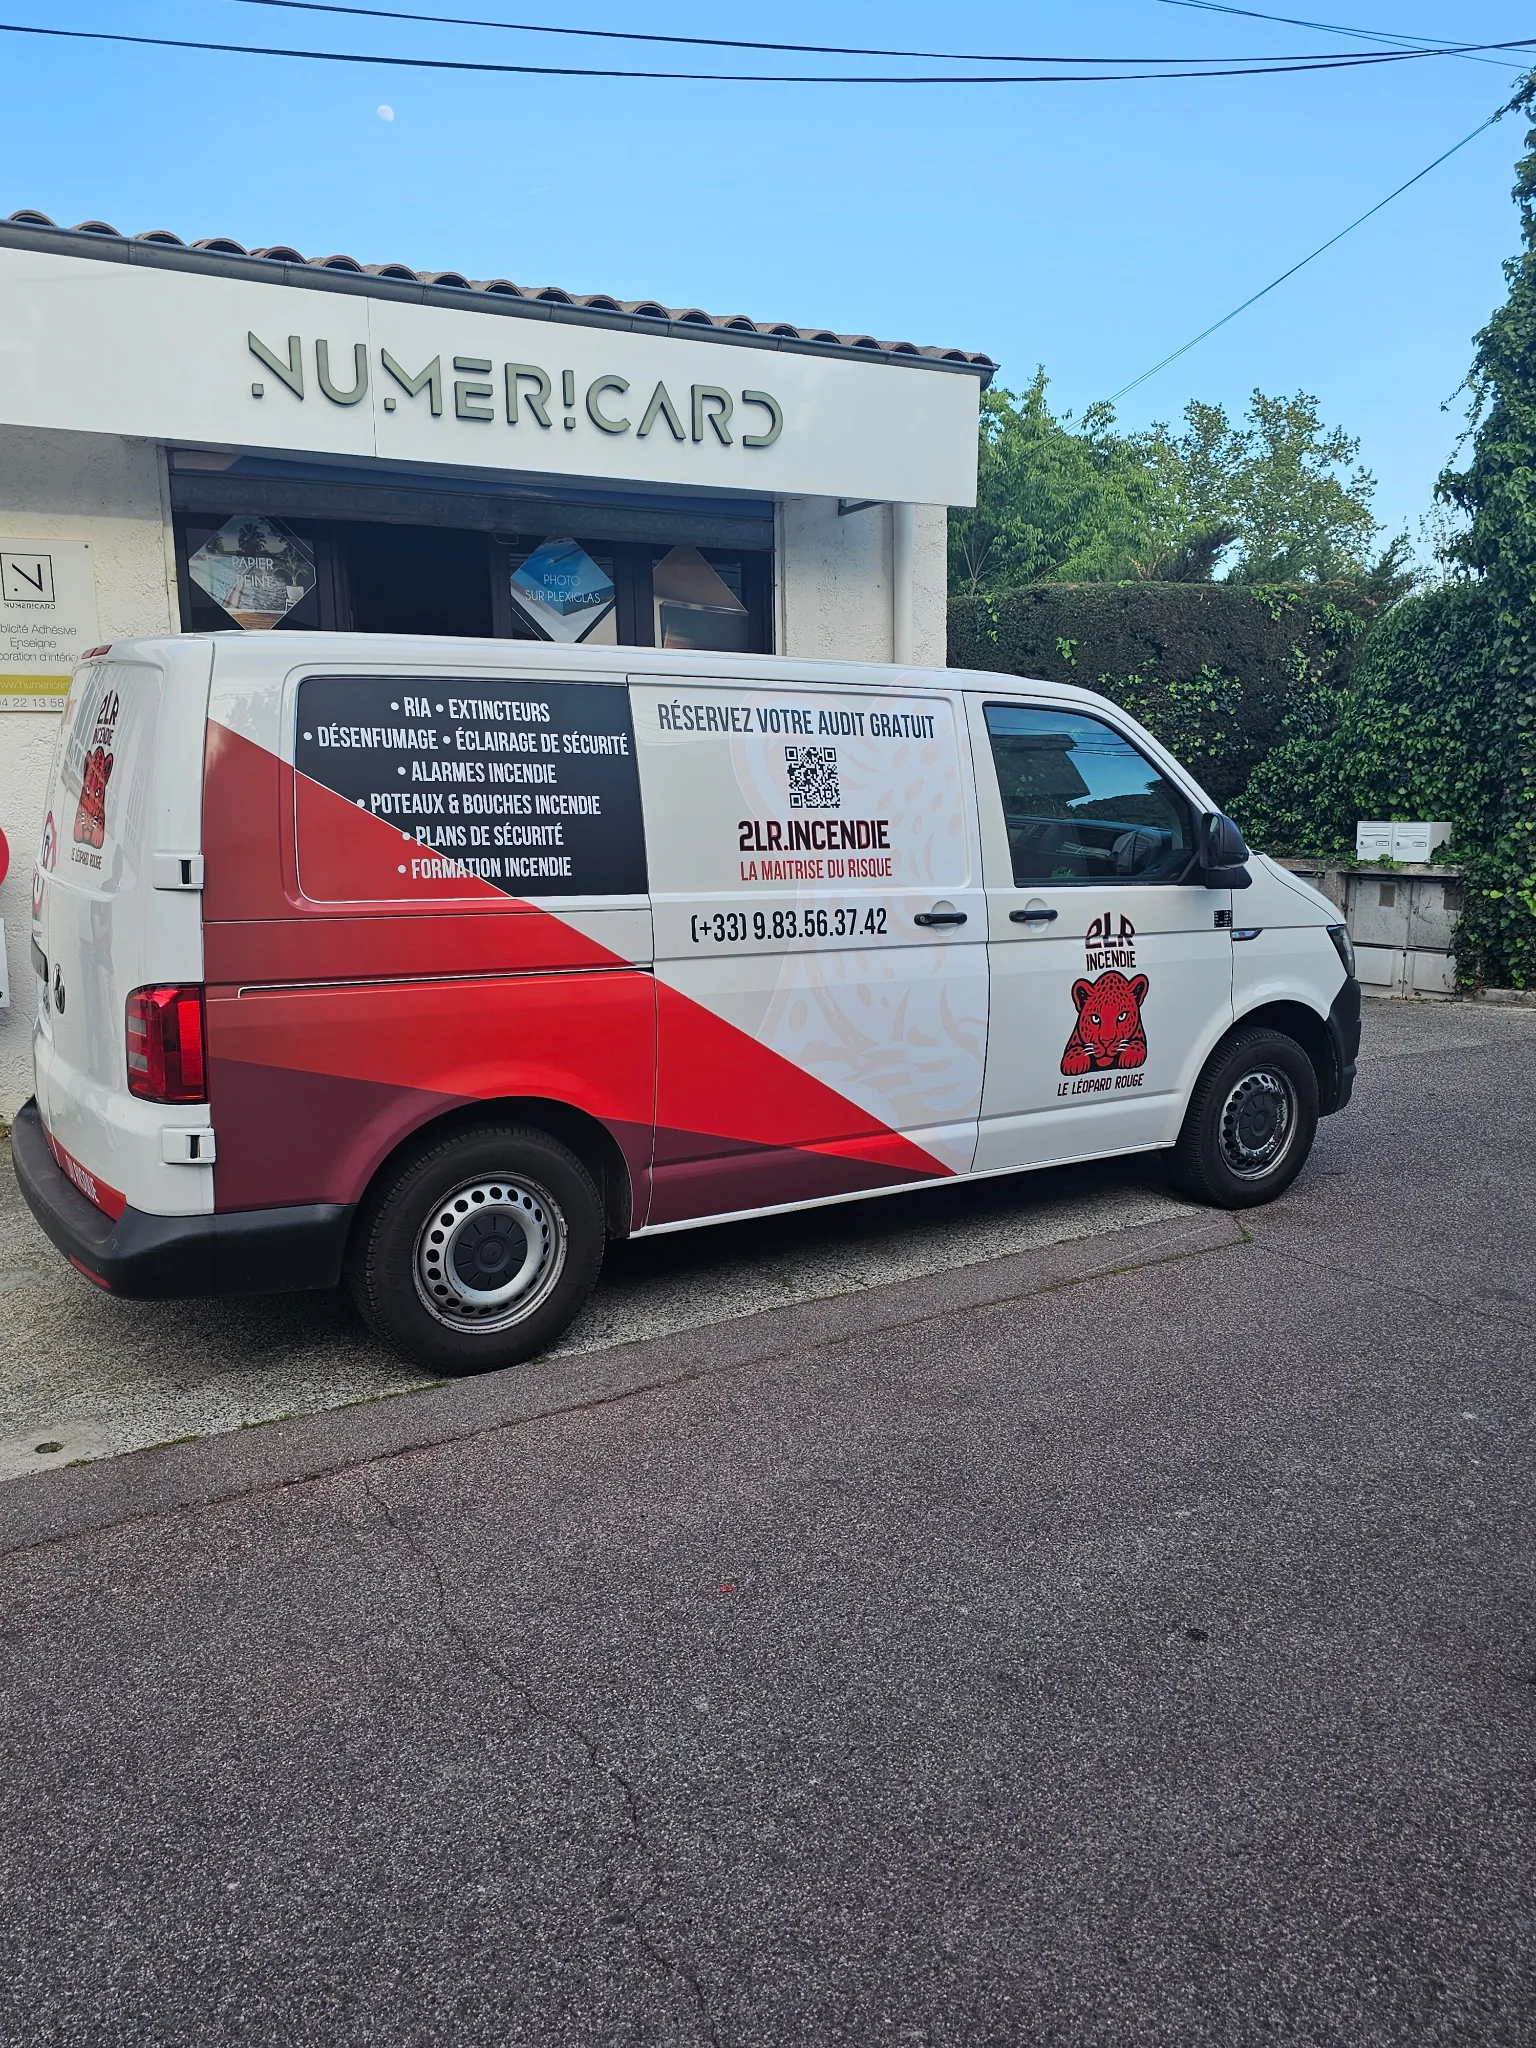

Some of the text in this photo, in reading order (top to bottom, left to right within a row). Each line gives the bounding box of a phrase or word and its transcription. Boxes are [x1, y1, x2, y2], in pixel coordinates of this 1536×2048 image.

[231, 556, 274, 570] PAPIER
[237, 574, 272, 588] PEINT
[543, 574, 581, 586] PHOTO
[525, 590, 601, 604] SUR PLEXIGLAS
[0, 623, 77, 635] blicité Adhésive
[10, 637, 57, 649] Enseigne
[13, 698, 28, 707] 22
[33, 698, 46, 707] 13
[50, 698, 65, 707] 58
[97, 690, 119, 725] 2LR
[404, 697, 551, 723] RIA EXTINCTEURS
[657, 700, 935, 739] RÉSERVEZ VOTRE AUDIT GRATUIT
[317, 723, 629, 756] DÉSENFUMAGE ÉCLAIRAGE DE SÉCURITÉ
[411, 761, 557, 784] ALARMES INCENDIE
[371, 794, 602, 815] POTEAUX & BOUCHES INCENDIE
[415, 822, 564, 846] PLANS DE SÉCURITÉ
[738, 820, 891, 851] 2LR.INCENDIE
[411, 857, 572, 879] FORMATION INCENDIE
[740, 857, 892, 881] LA MAITRISE DU RISQUE
[691, 907, 887, 943] (+33) 9.83.56.37.42
[1085, 911, 1136, 950] 2LR
[1085, 950, 1137, 972] INCENDIE
[1057, 1073, 1145, 1097] LE LÉOPARD ROUGE
